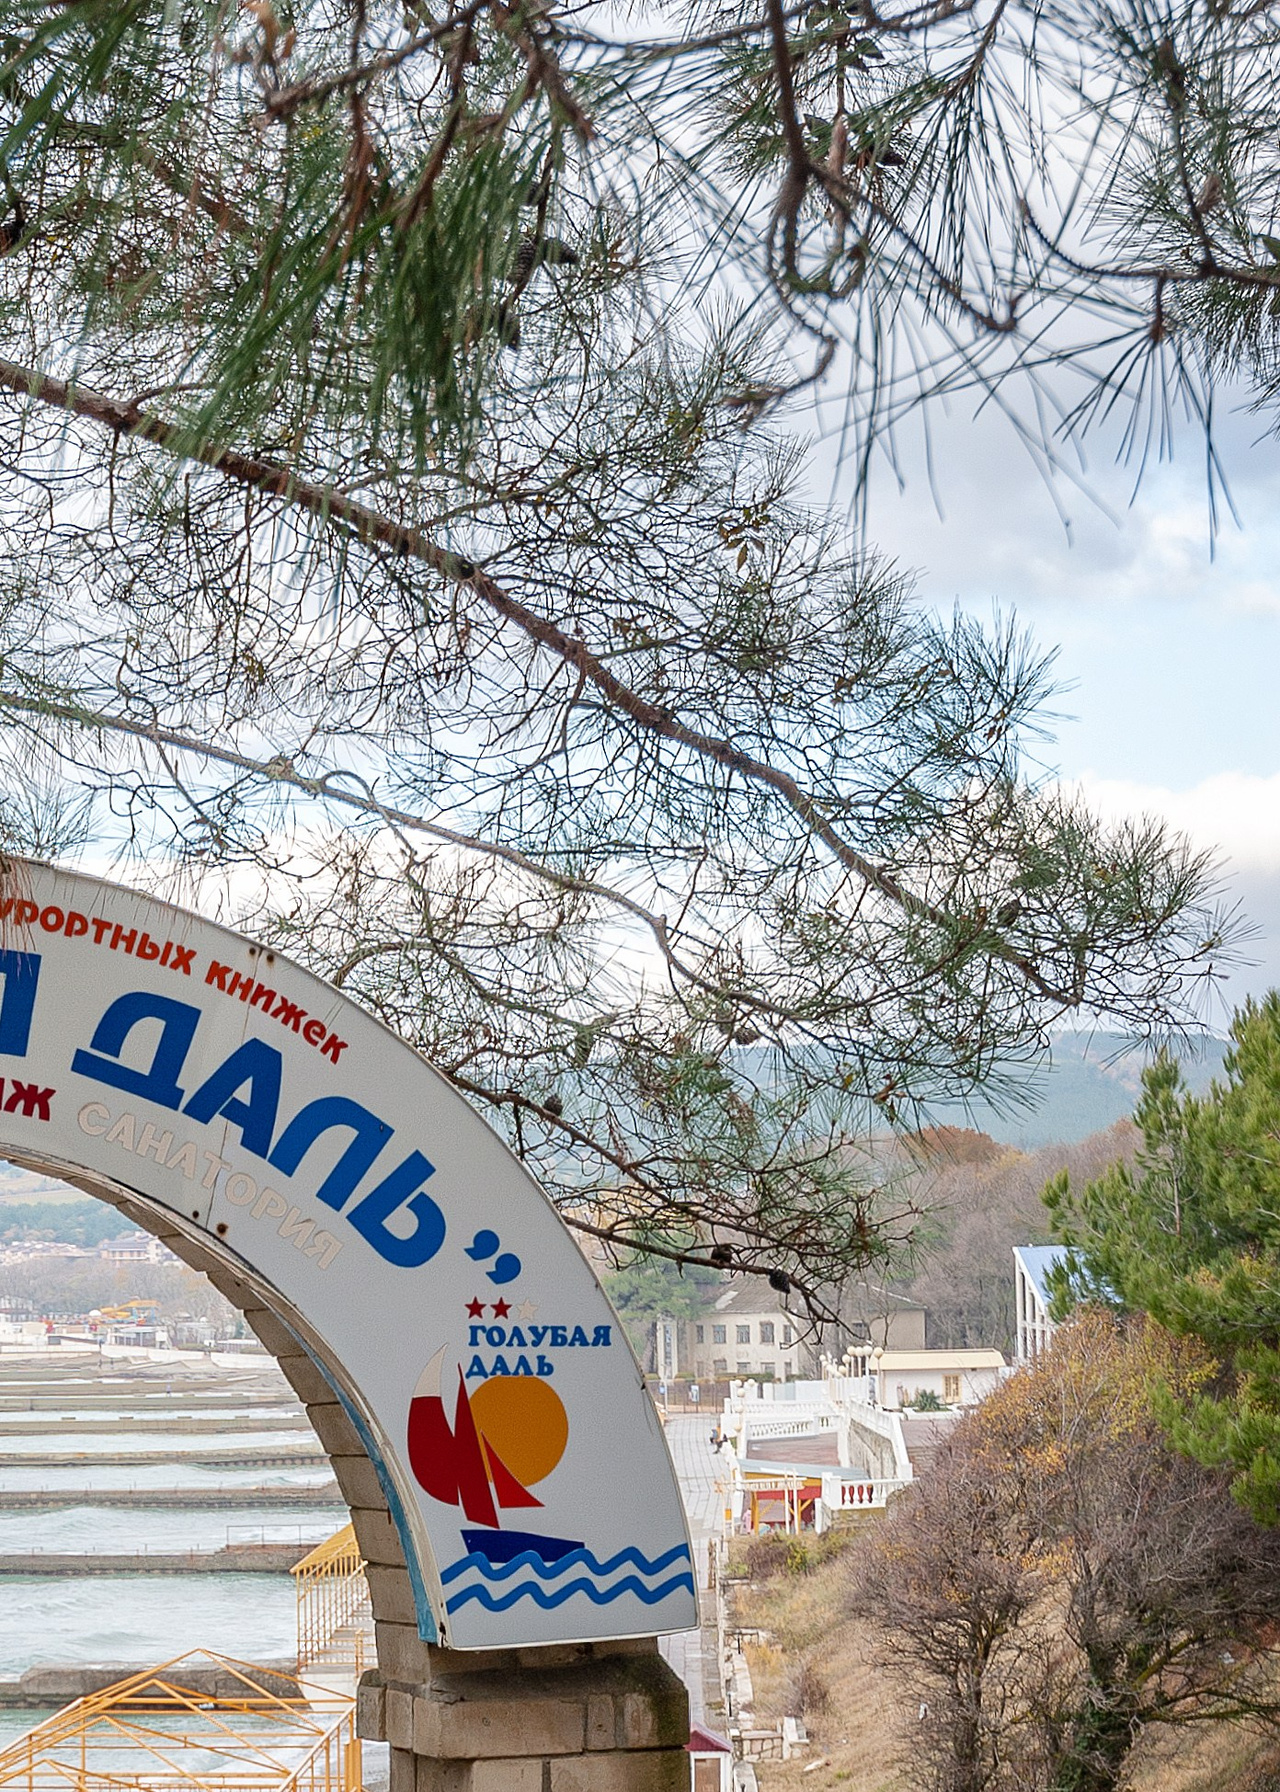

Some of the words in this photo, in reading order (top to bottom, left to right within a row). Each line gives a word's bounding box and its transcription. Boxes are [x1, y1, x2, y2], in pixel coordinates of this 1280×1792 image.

[205, 960, 349, 1065] книжек
[77, 1101, 344, 1270] САНАТОРИЯ
[465, 1354, 555, 1379] ДАЛЬ
[468, 1325, 612, 1348] ГОЛУБАЯ
